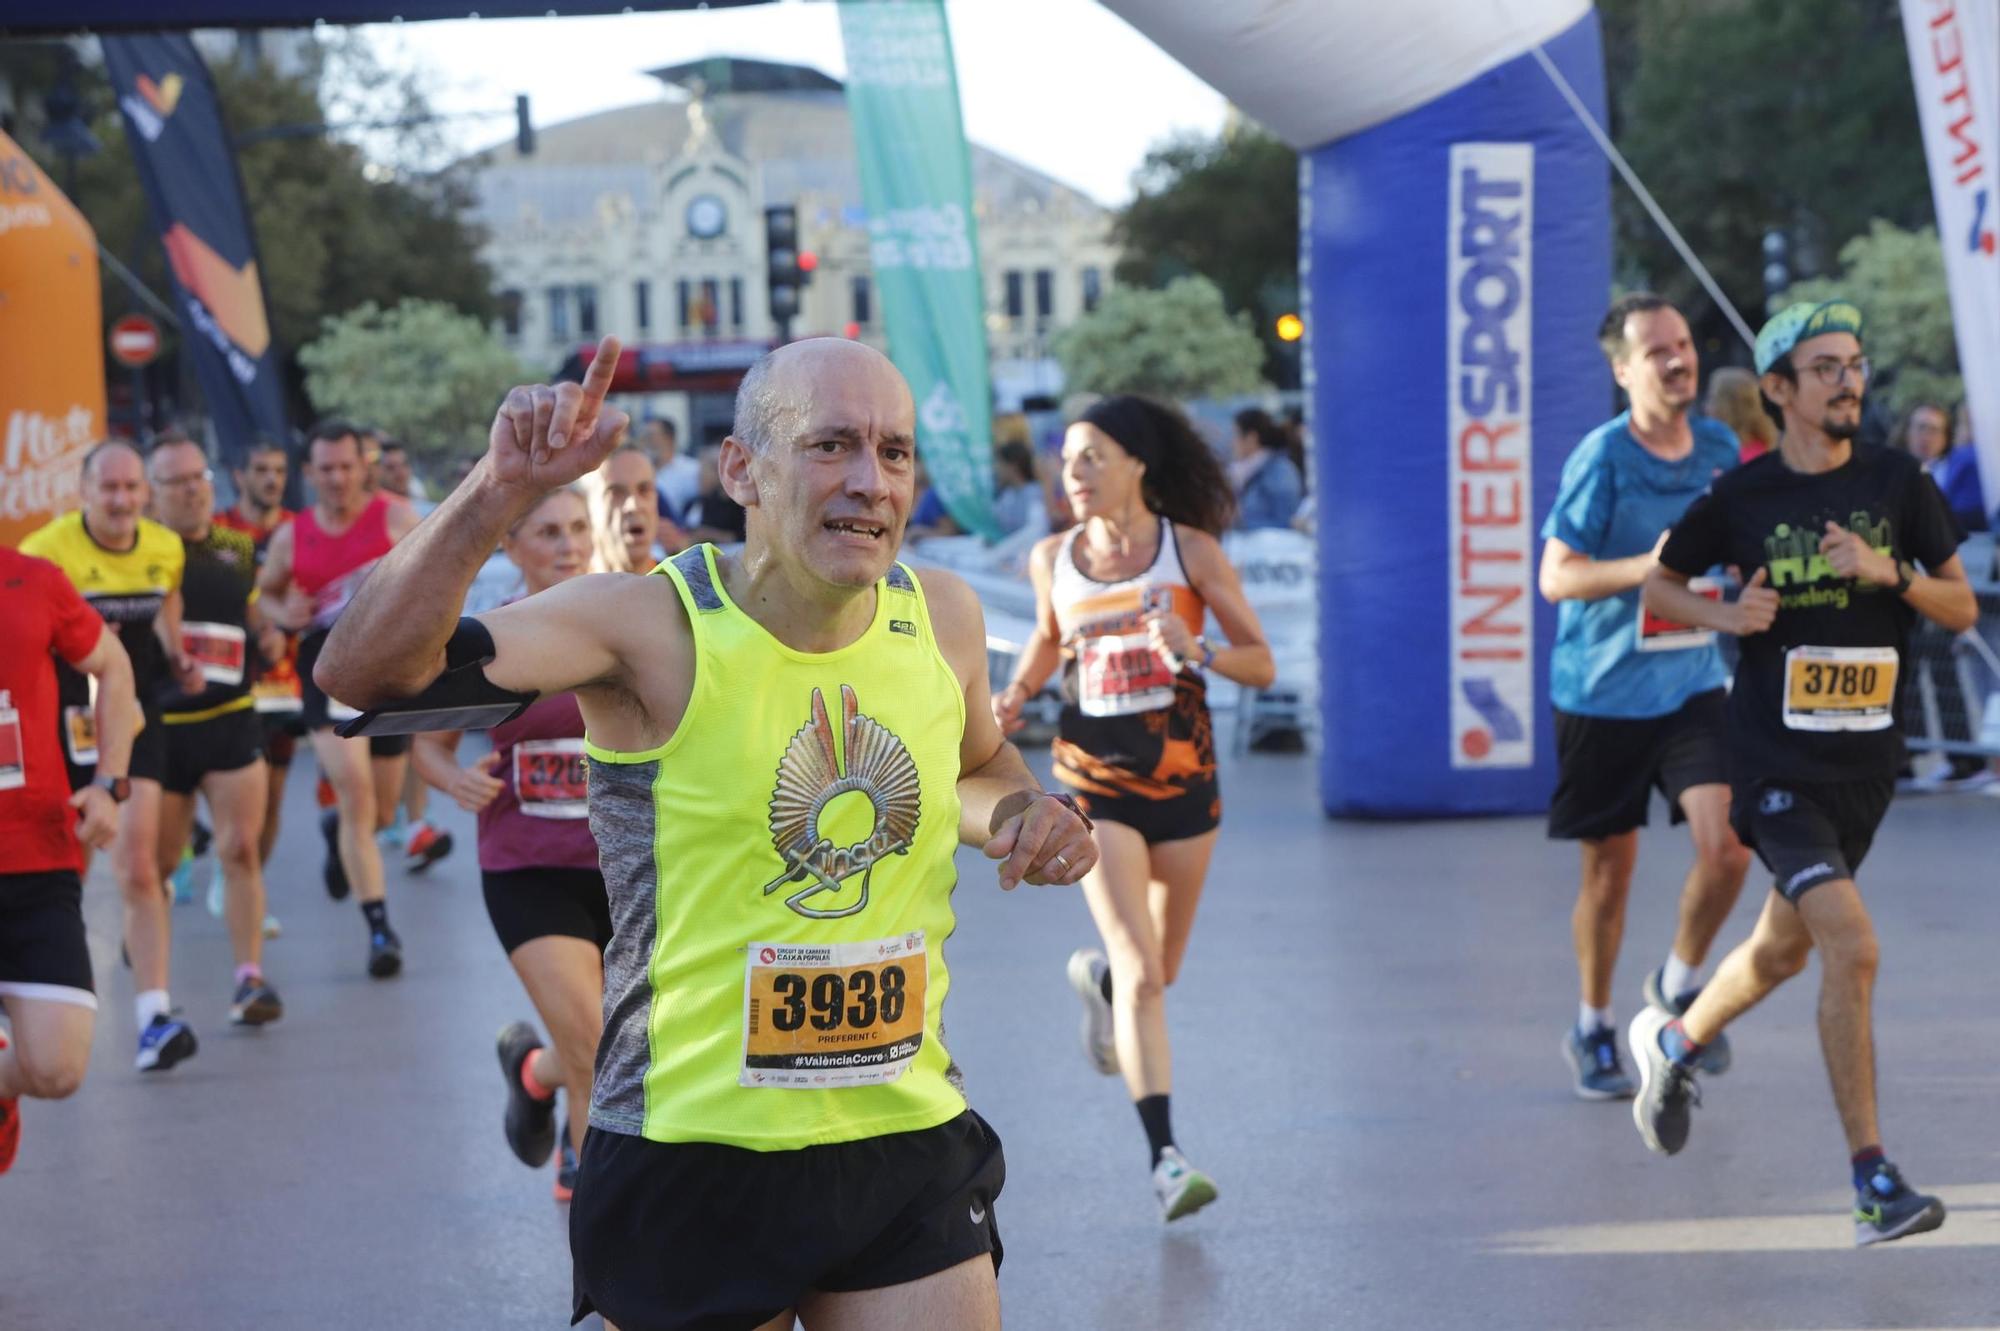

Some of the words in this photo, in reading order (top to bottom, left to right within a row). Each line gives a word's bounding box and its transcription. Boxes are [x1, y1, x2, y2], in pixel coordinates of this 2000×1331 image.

[1459, 167, 1524, 663] INTERSPORT
[1805, 663, 1877, 696] 3780
[772, 965, 906, 1032] 3938
[818, 1033, 869, 1044] PREFERENT
[871, 1032, 878, 1040] C
